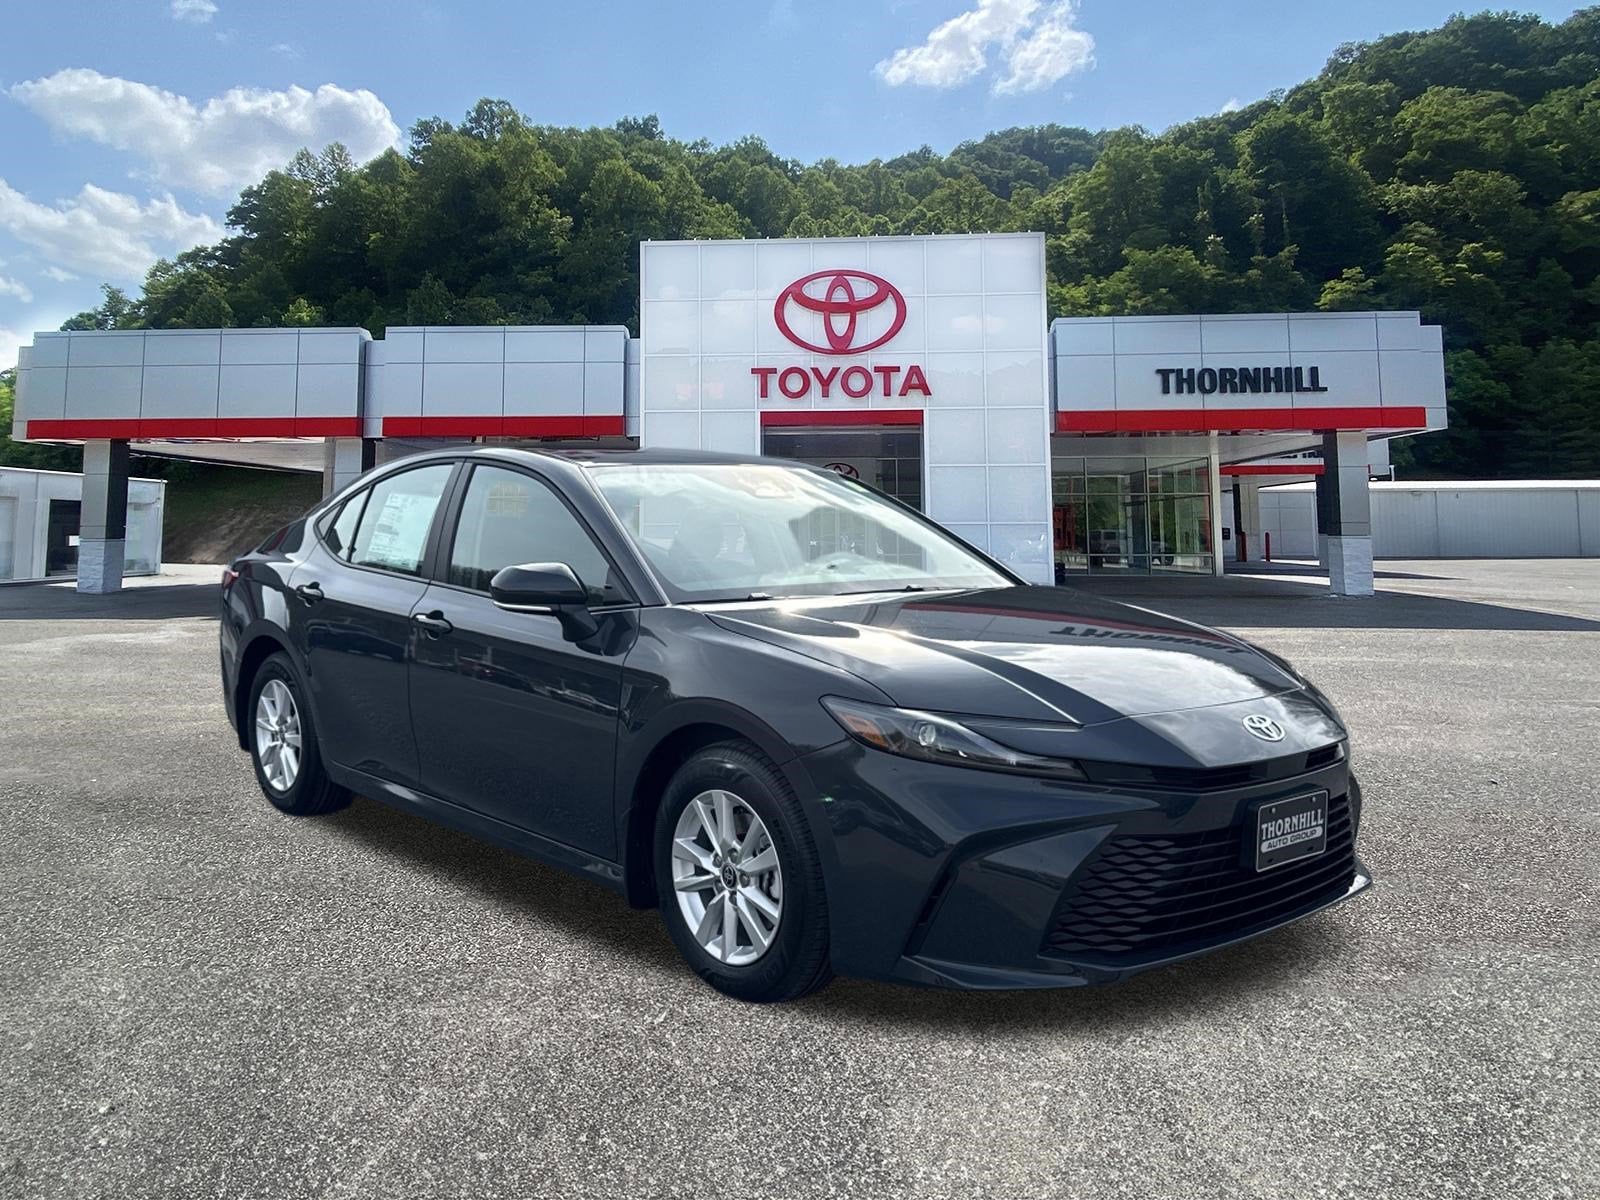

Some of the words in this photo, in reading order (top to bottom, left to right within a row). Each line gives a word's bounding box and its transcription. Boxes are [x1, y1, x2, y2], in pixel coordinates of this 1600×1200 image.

[751, 365, 932, 399] TOYOTA
[1156, 366, 1328, 395] THORNHILL
[1261, 809, 1324, 840] THORNHILL
[1267, 837, 1289, 850] AUTO
[1290, 829, 1317, 843] GROUP
